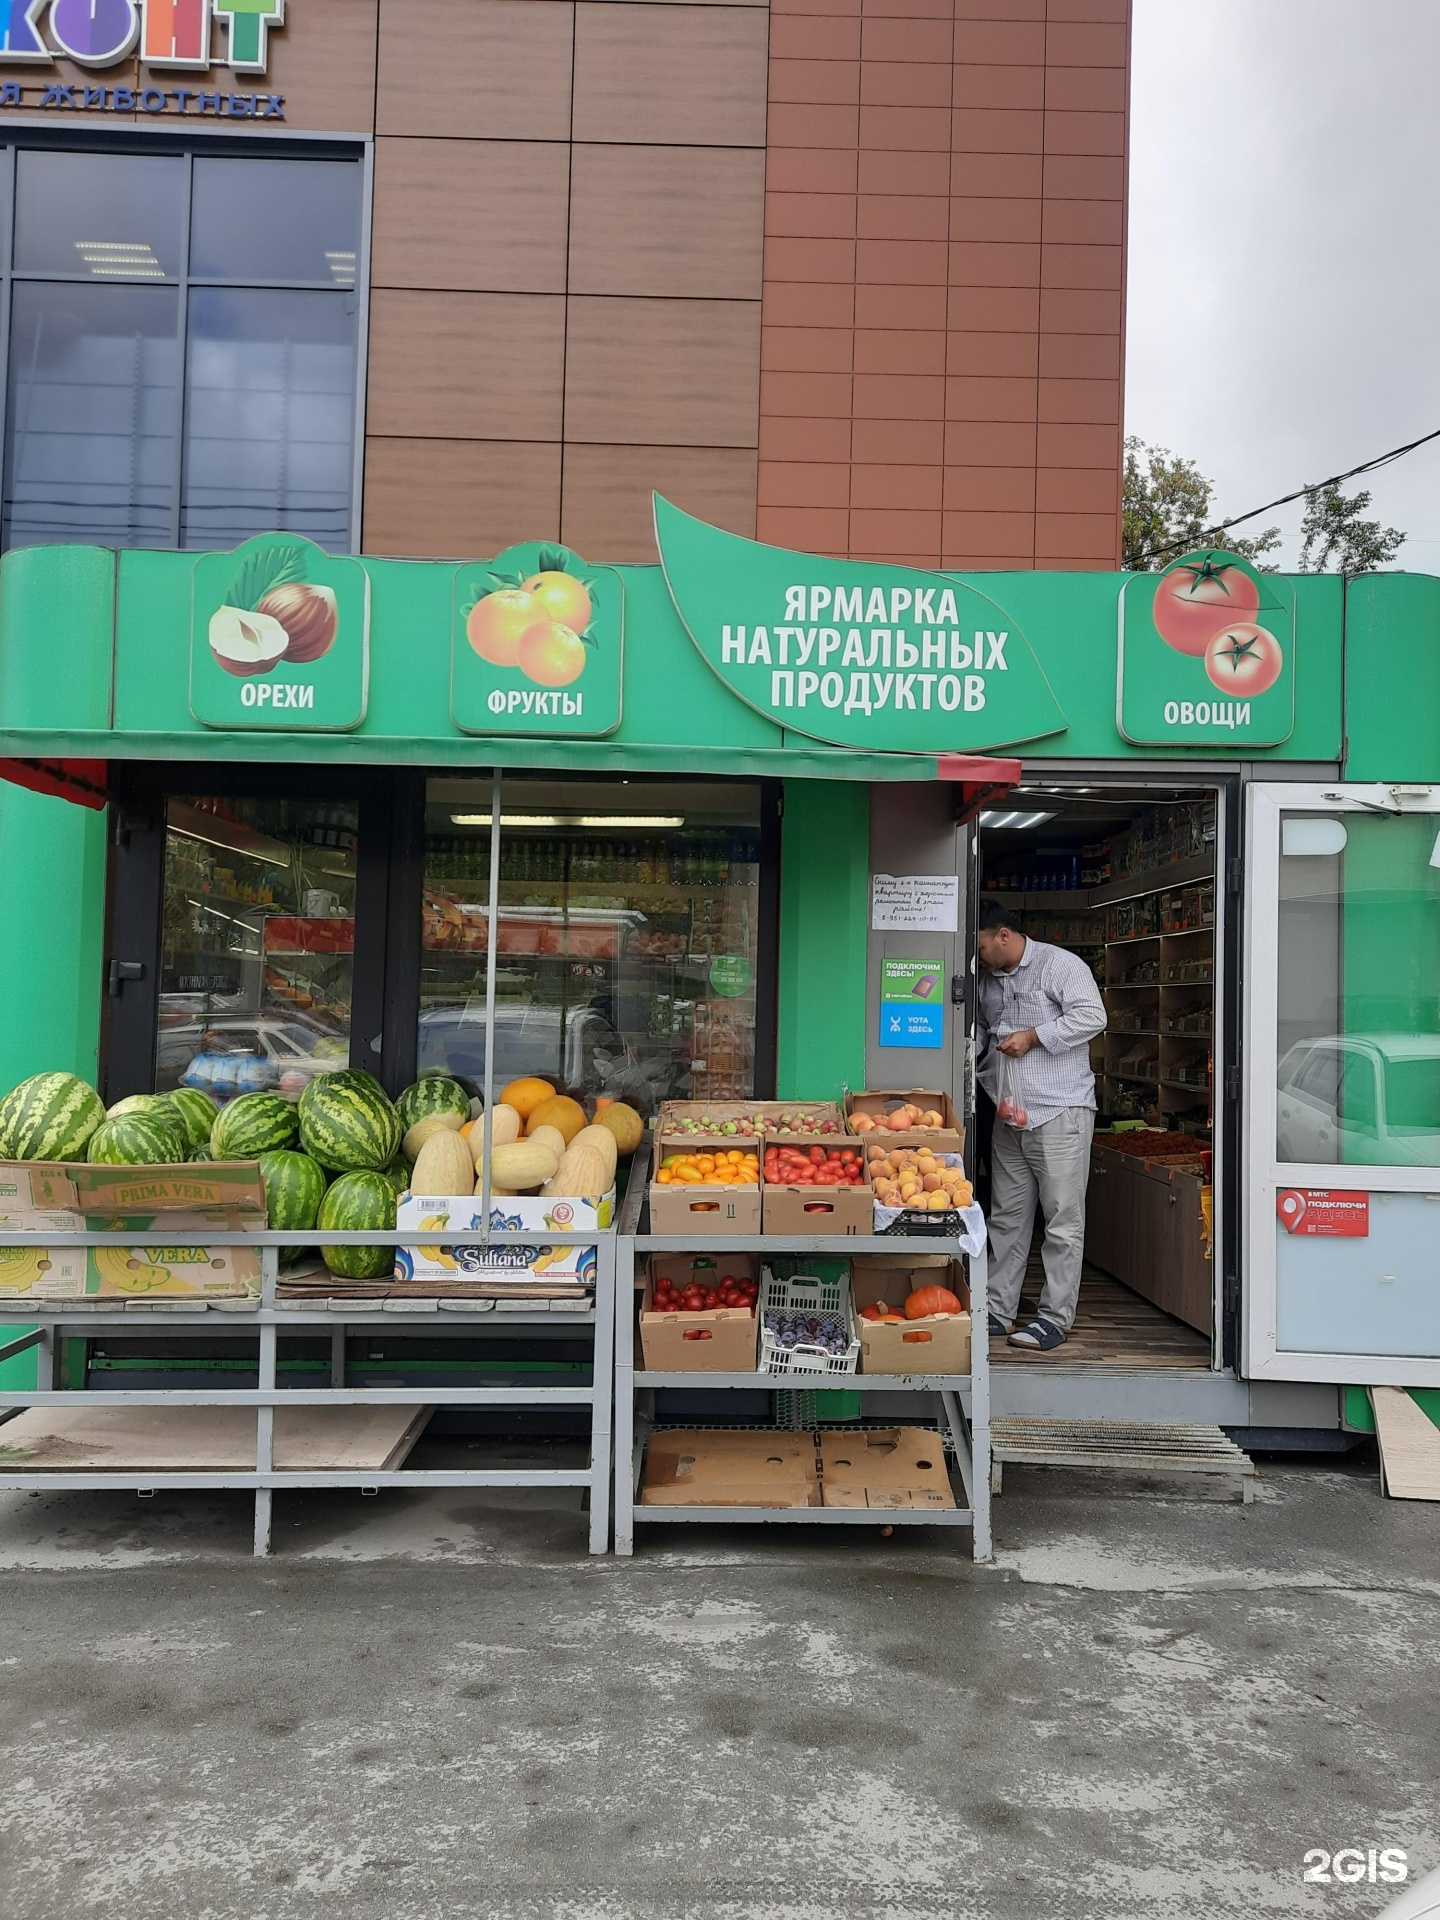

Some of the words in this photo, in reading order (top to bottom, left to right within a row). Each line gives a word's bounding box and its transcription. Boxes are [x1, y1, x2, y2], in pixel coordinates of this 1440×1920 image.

[42, 85, 287, 118] ЖИВОТНЫХ
[784, 584, 959, 624] ЯРМАРКА
[721, 625, 1009, 671] НАТУРАЛЬНЫХ
[240, 682, 314, 709] ОРЕХИ
[487, 689, 583, 716] ФРУКТЫ
[771, 670, 986, 716] ПРОДУКТОВ
[1164, 701, 1251, 730] ОВОЩИ
[886, 962, 941, 970] ПОДКЛЮЧИМ
[120, 1184, 169, 1202] PRIMA
[173, 1183, 214, 1200] VERA
[145, 1247, 211, 1264] VERA
[462, 1249, 528, 1271] Sultana
